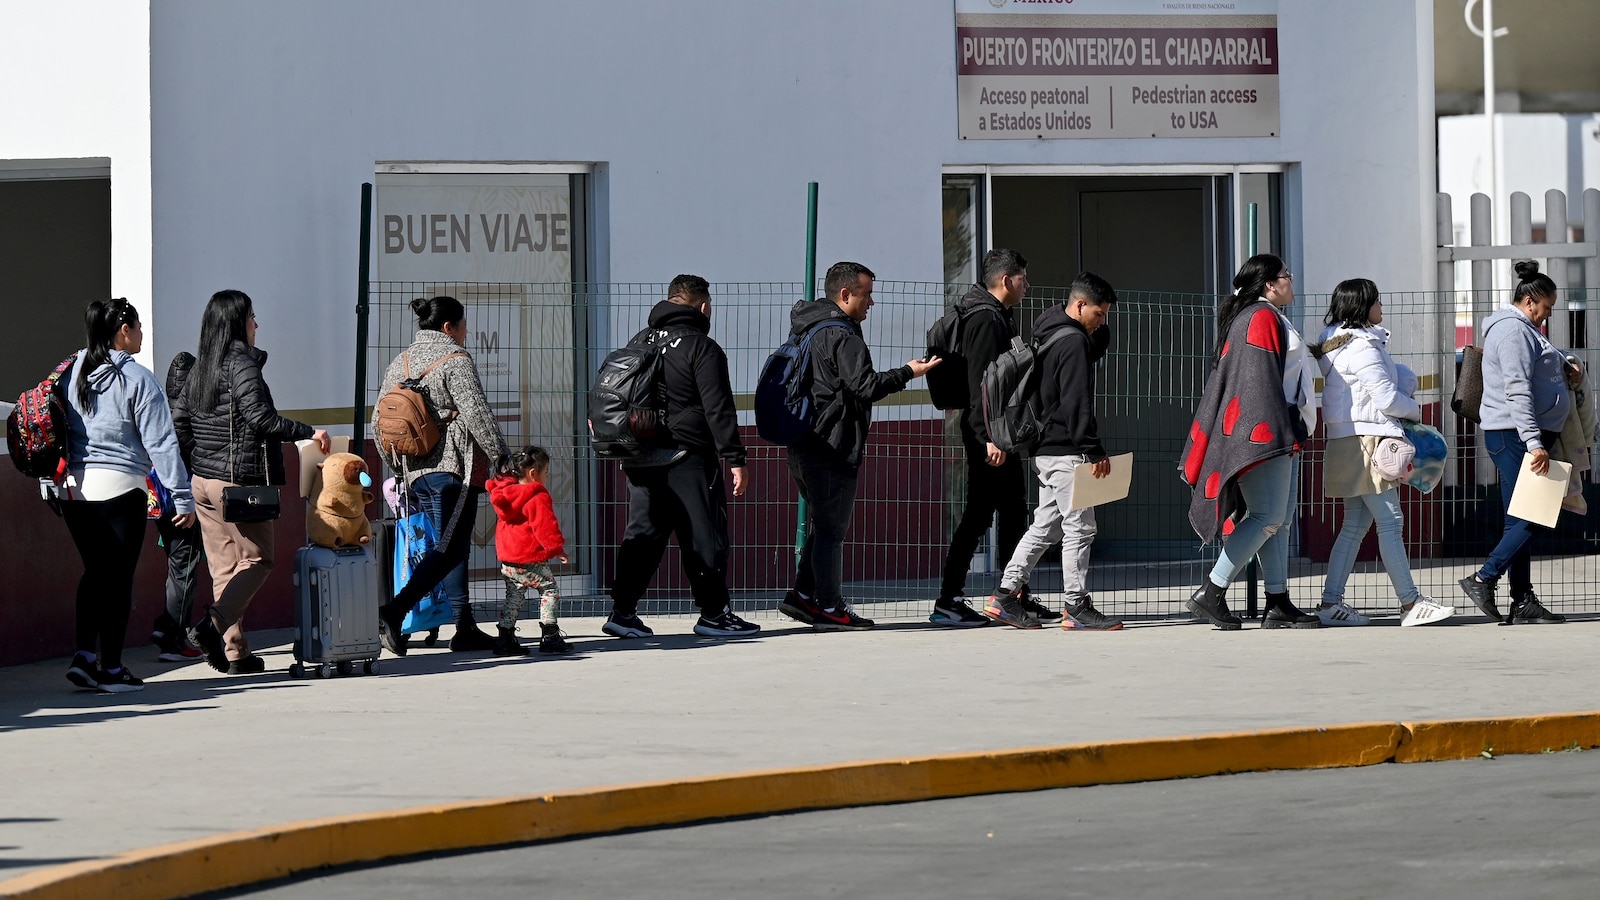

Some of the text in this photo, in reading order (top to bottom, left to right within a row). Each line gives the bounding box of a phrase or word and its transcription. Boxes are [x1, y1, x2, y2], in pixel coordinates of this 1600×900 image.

[963, 37, 1272, 66] PUERTO FRONTERIZO EL CHAPARRAL
[979, 86, 1089, 109] Acceso peatonal
[1132, 84, 1258, 105] Pedestrian access
[979, 110, 1092, 131] a Estados Unidos
[1170, 111, 1219, 130] to USA
[384, 213, 568, 254] BUEN VIAJE
